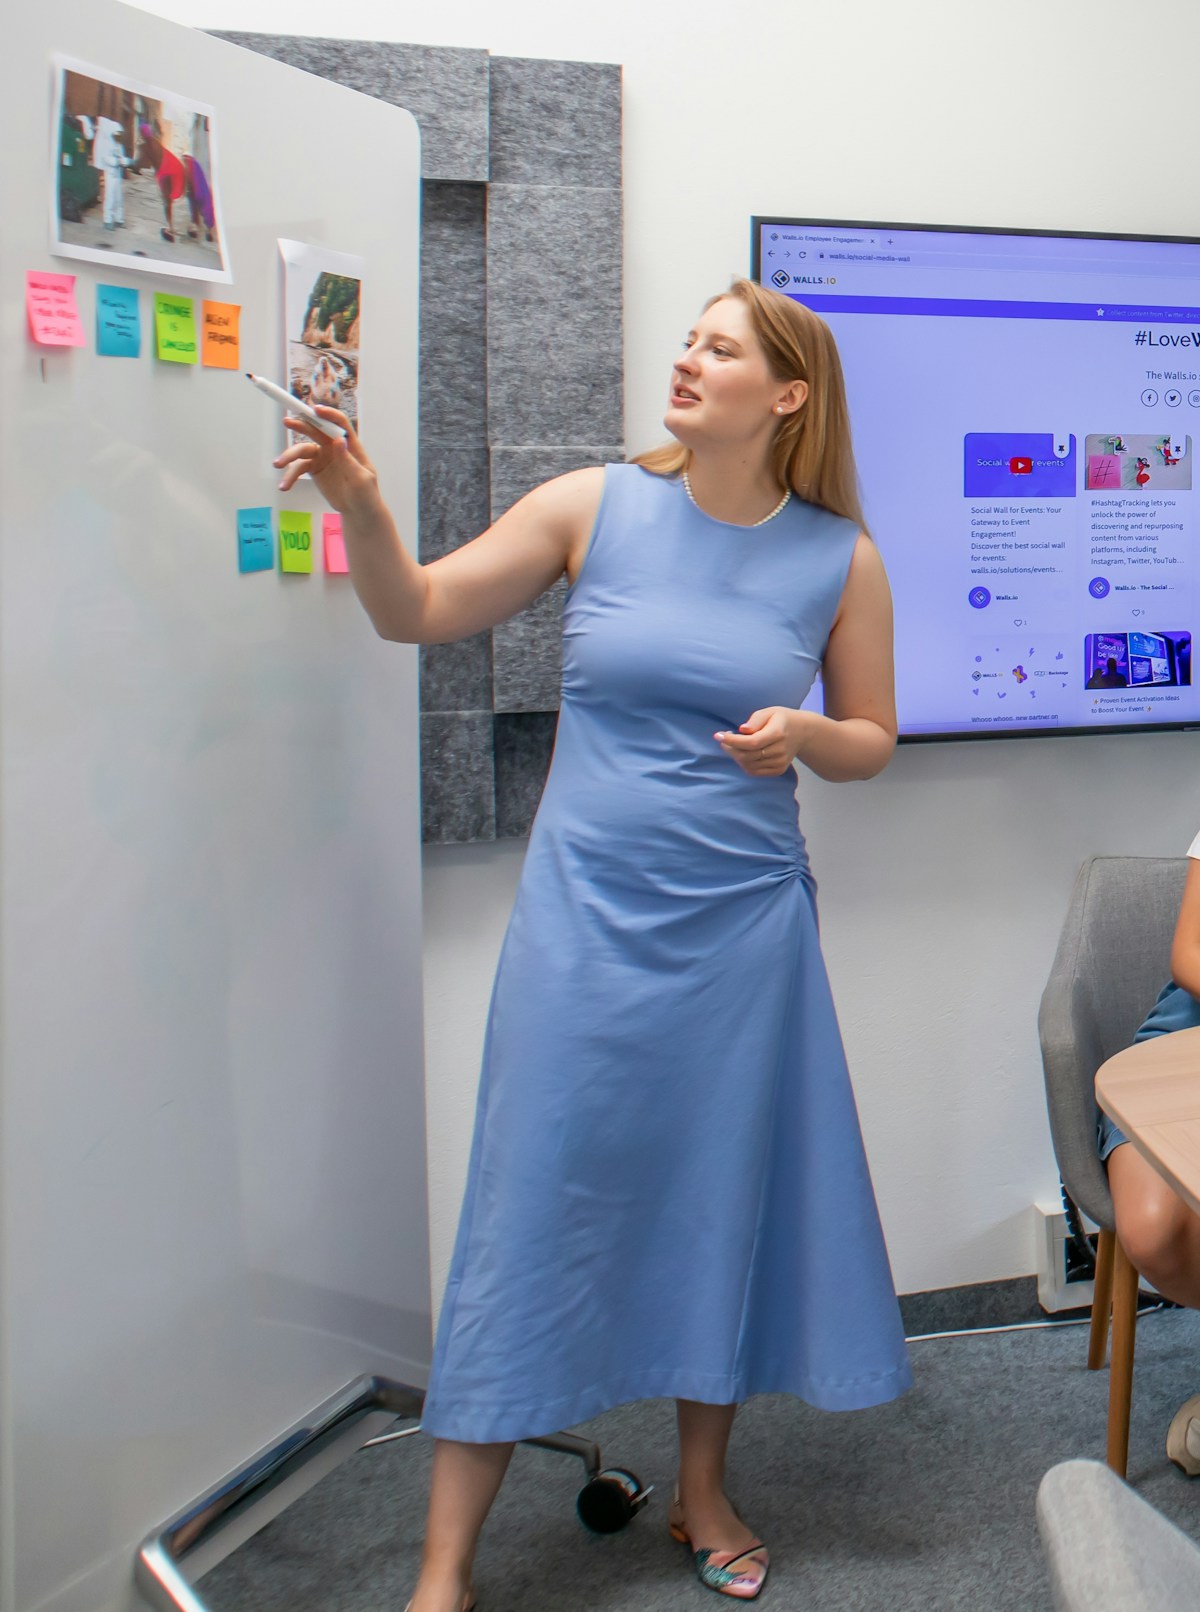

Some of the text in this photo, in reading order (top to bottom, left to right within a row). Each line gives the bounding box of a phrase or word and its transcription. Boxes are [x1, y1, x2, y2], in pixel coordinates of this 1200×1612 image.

[804, 235, 832, 243] Employee
[829, 253, 911, 262] walls.io/social-media-wall
[793, 276, 837, 285] WALLS.IO
[1128, 310, 1149, 318] content
[1146, 370, 1163, 380] The
[1164, 371, 1198, 381] Walls.io
[977, 459, 1002, 468] Social
[1091, 499, 1176, 508] #HashtagTracking lets you
[970, 506, 1062, 514] Social Wall for Events: Your
[1091, 511, 1114, 519] unlock
[1114, 511, 1126, 519] the
[1149, 510, 1156, 518] of
[970, 518, 1001, 528] Gateway
[1010, 518, 1030, 526] Event
[1091, 522, 1184, 532] discovering and repurposing
[970, 530, 1017, 540] Engagement!
[281, 530, 310, 551] YOLO
[970, 542, 1066, 550] Discover the best social wall
[1091, 546, 1157, 555] platforms, including
[970, 554, 982, 562] for
[1091, 558, 1126, 567] Instagram,
[1128, 557, 1152, 566] Twitter,
